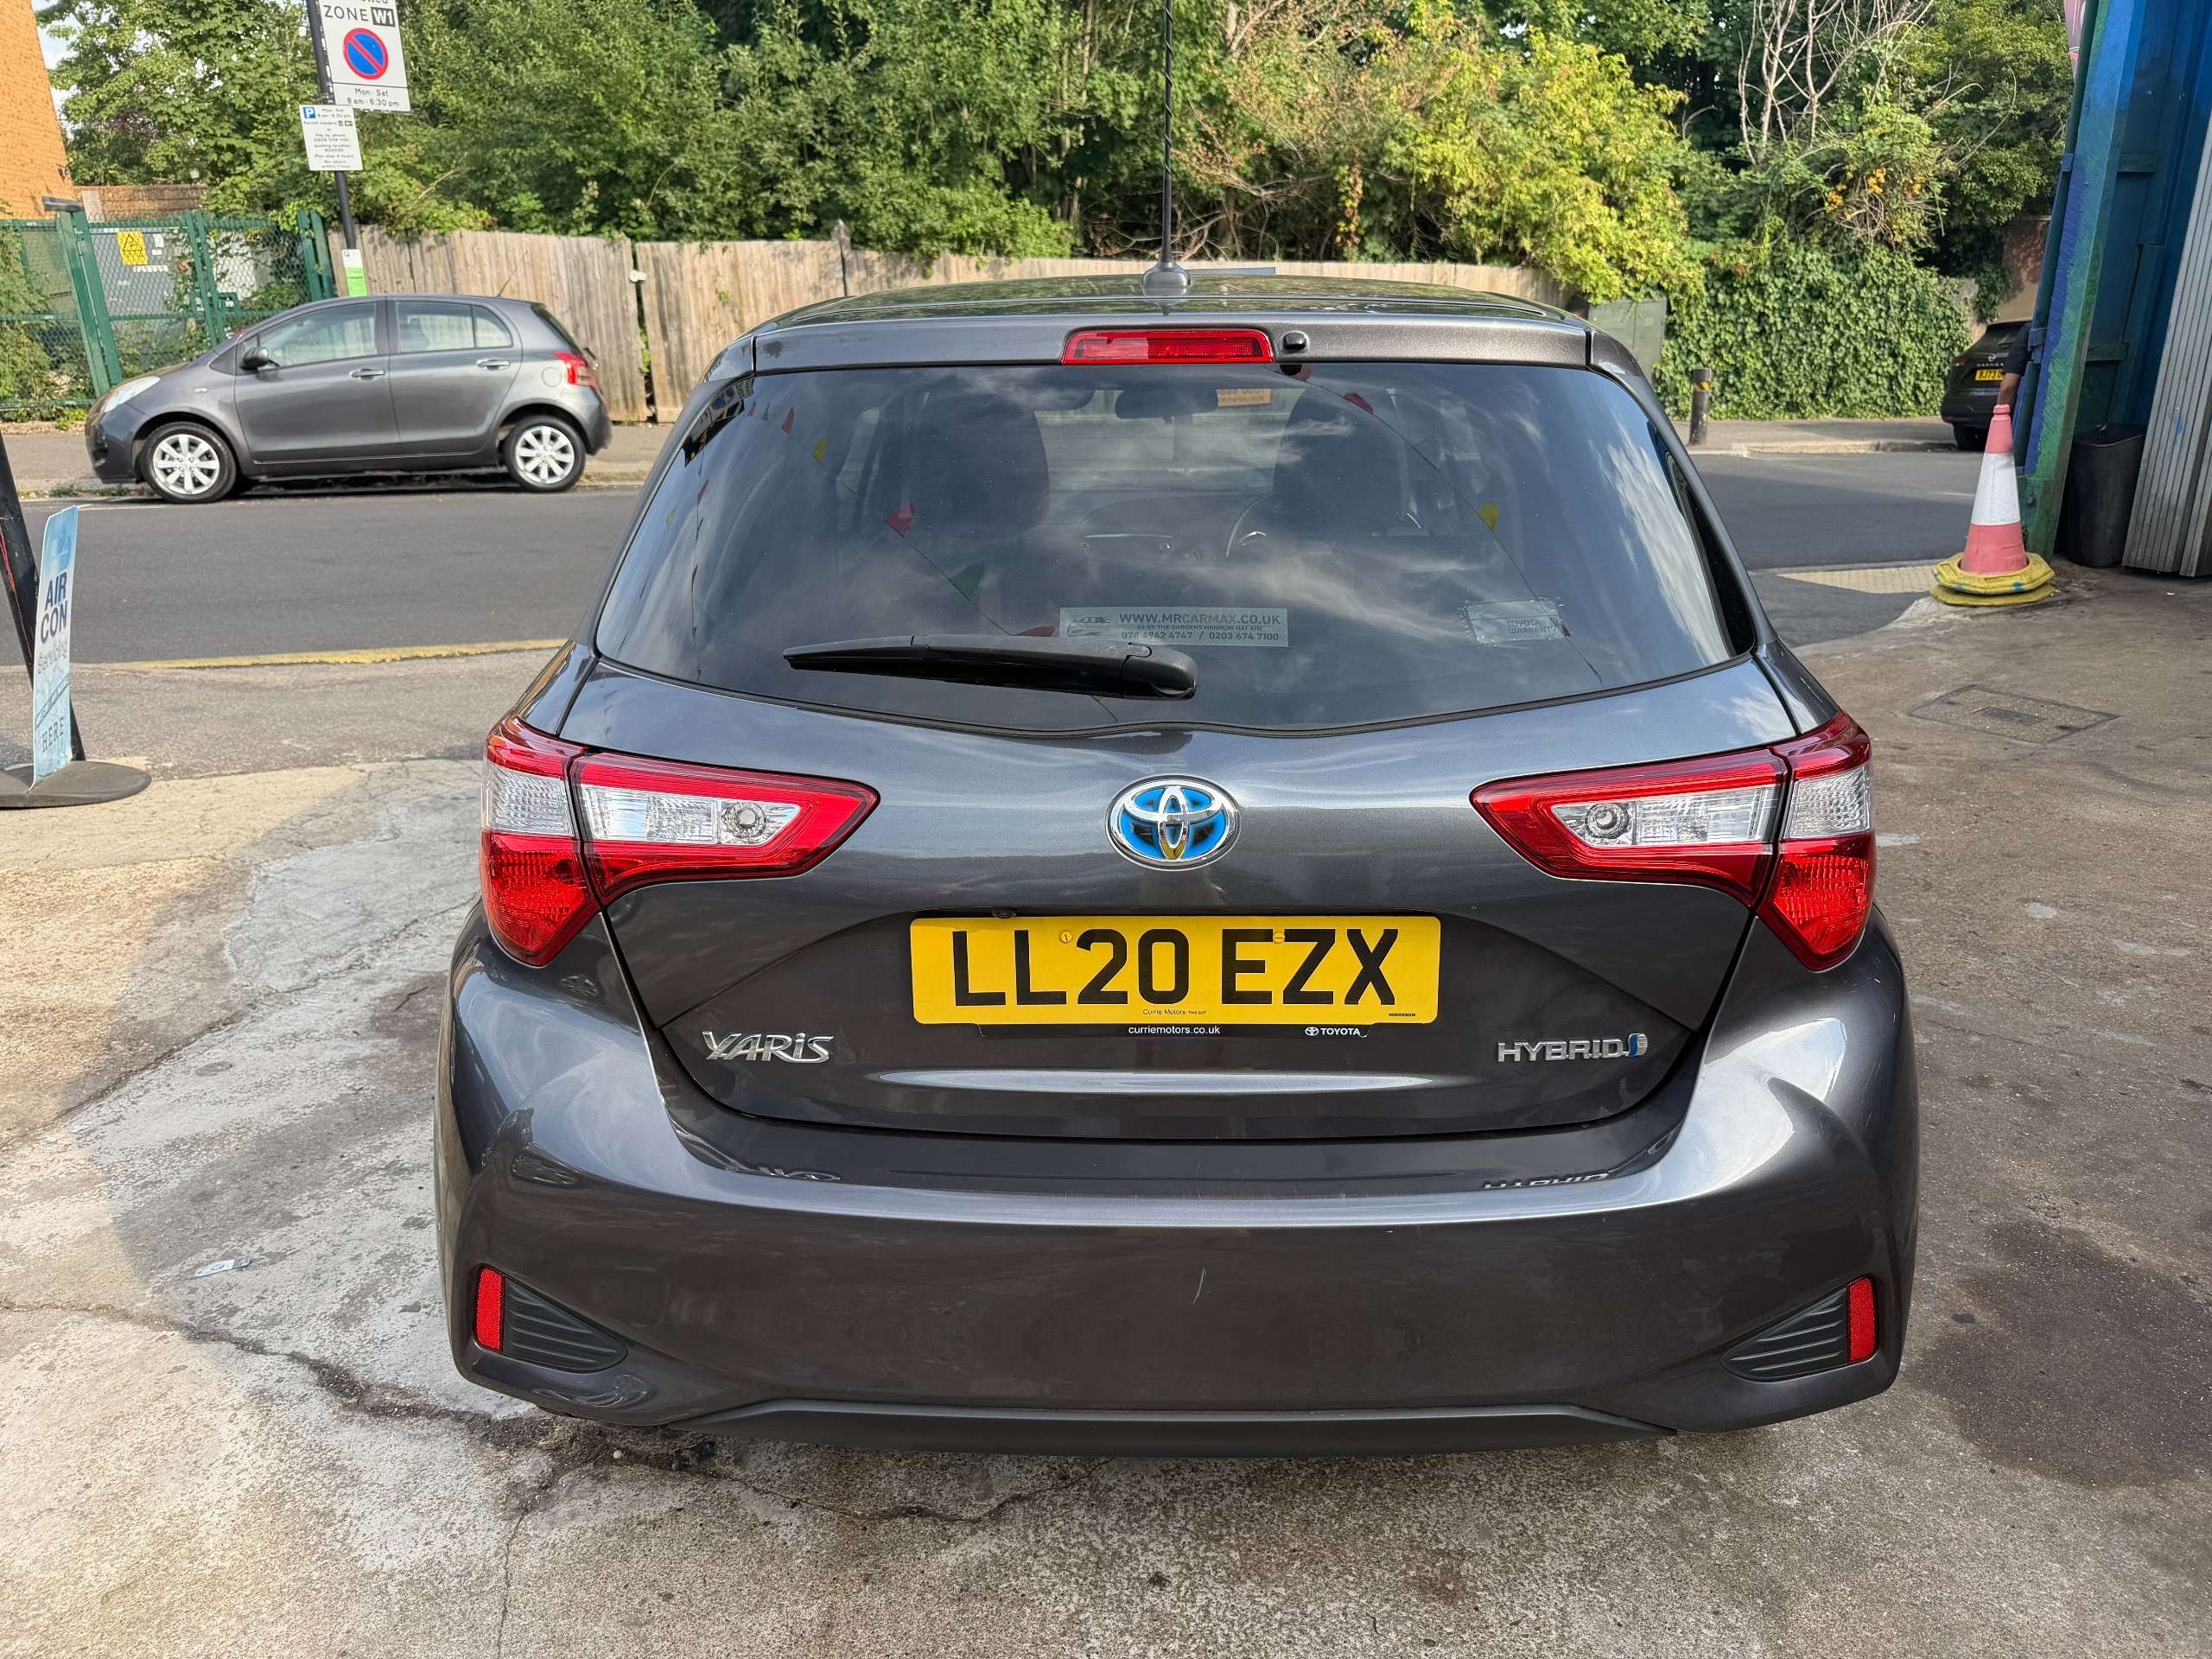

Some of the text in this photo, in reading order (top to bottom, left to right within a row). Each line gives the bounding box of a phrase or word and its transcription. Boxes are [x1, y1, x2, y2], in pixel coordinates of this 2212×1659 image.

[323, 5, 395, 26] ZONE W1
[45, 572, 67, 613] AIR
[41, 600, 68, 645] CON
[1120, 613, 1281, 625] WWW.MRCARMAX.CO.UK
[952, 928, 1399, 1007] LL20 EZX
[1128, 1025, 1221, 1034] curriemotors.co.uk
[1320, 1027, 1361, 1036] TOYOTA
[1497, 1039, 1624, 1063] HYBRID
